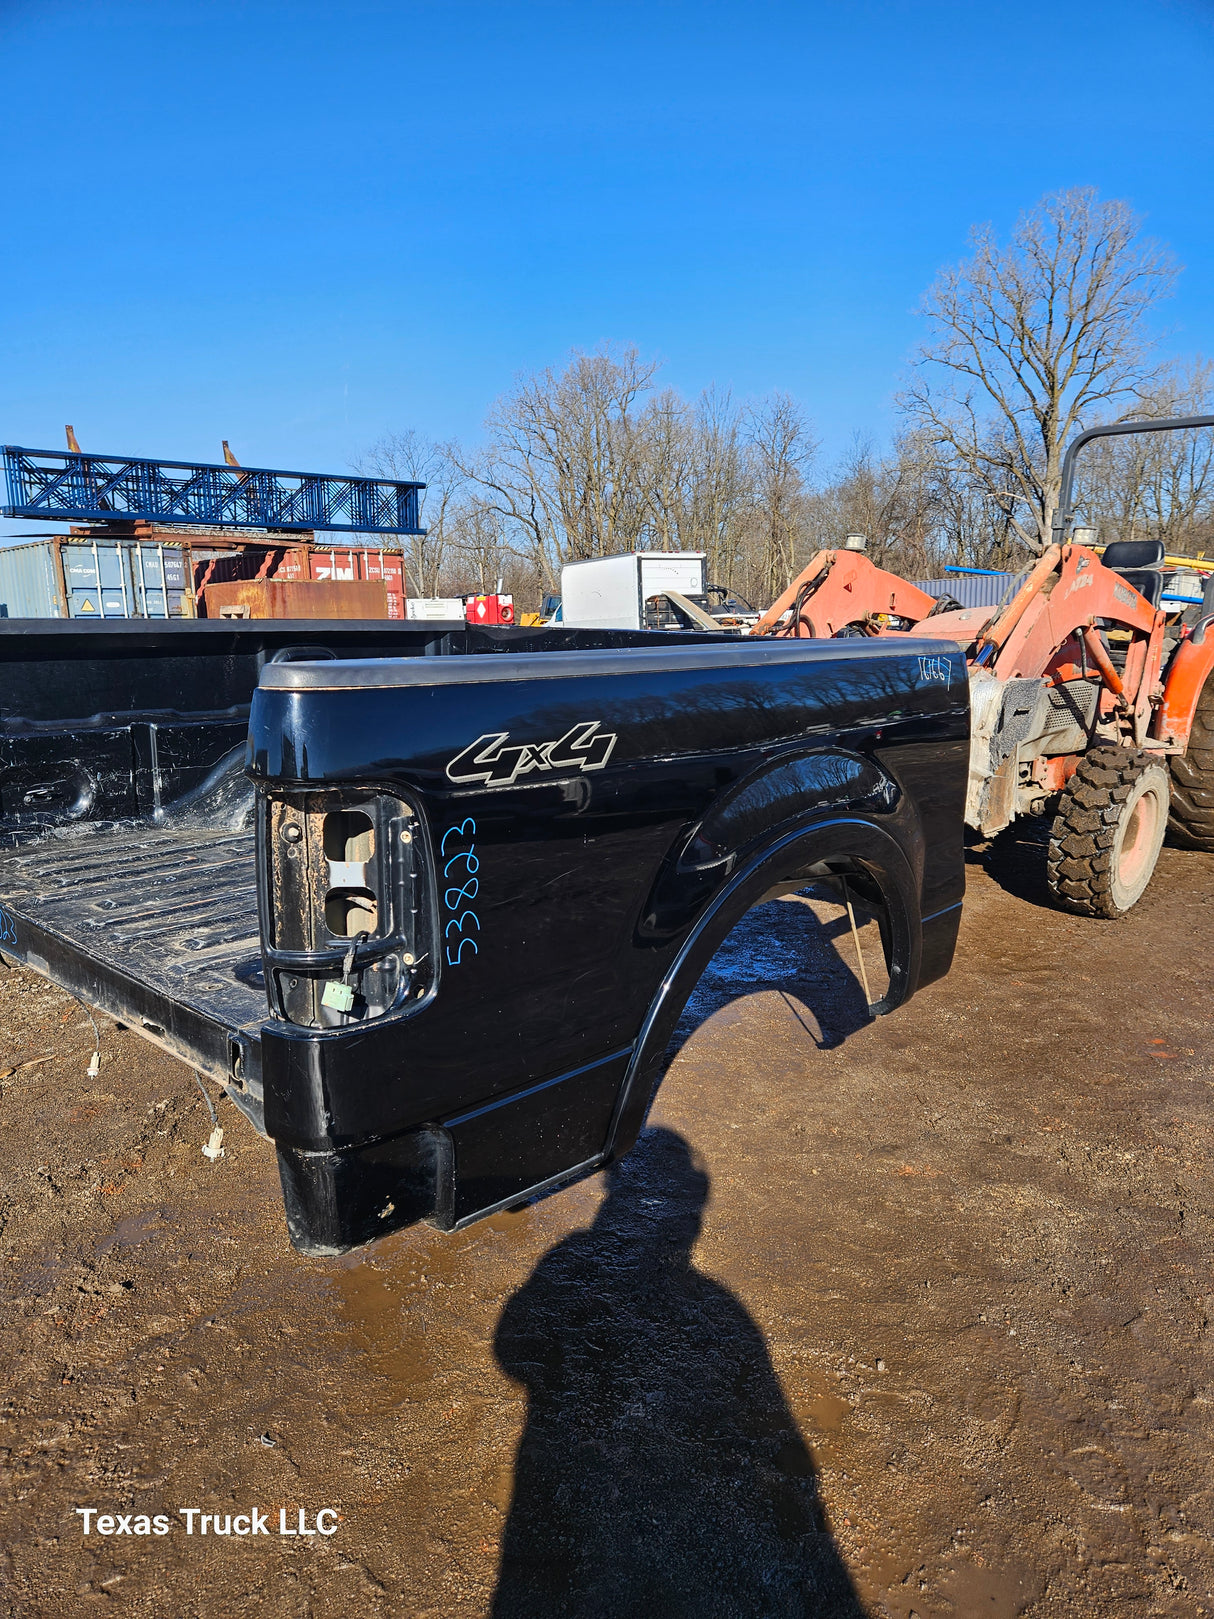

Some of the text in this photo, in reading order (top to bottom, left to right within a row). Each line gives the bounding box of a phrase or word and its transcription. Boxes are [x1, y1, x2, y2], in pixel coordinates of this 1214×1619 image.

[315, 566, 354, 580] ZIM
[446, 721, 618, 787] 4x4
[441, 817, 480, 966] 53823
